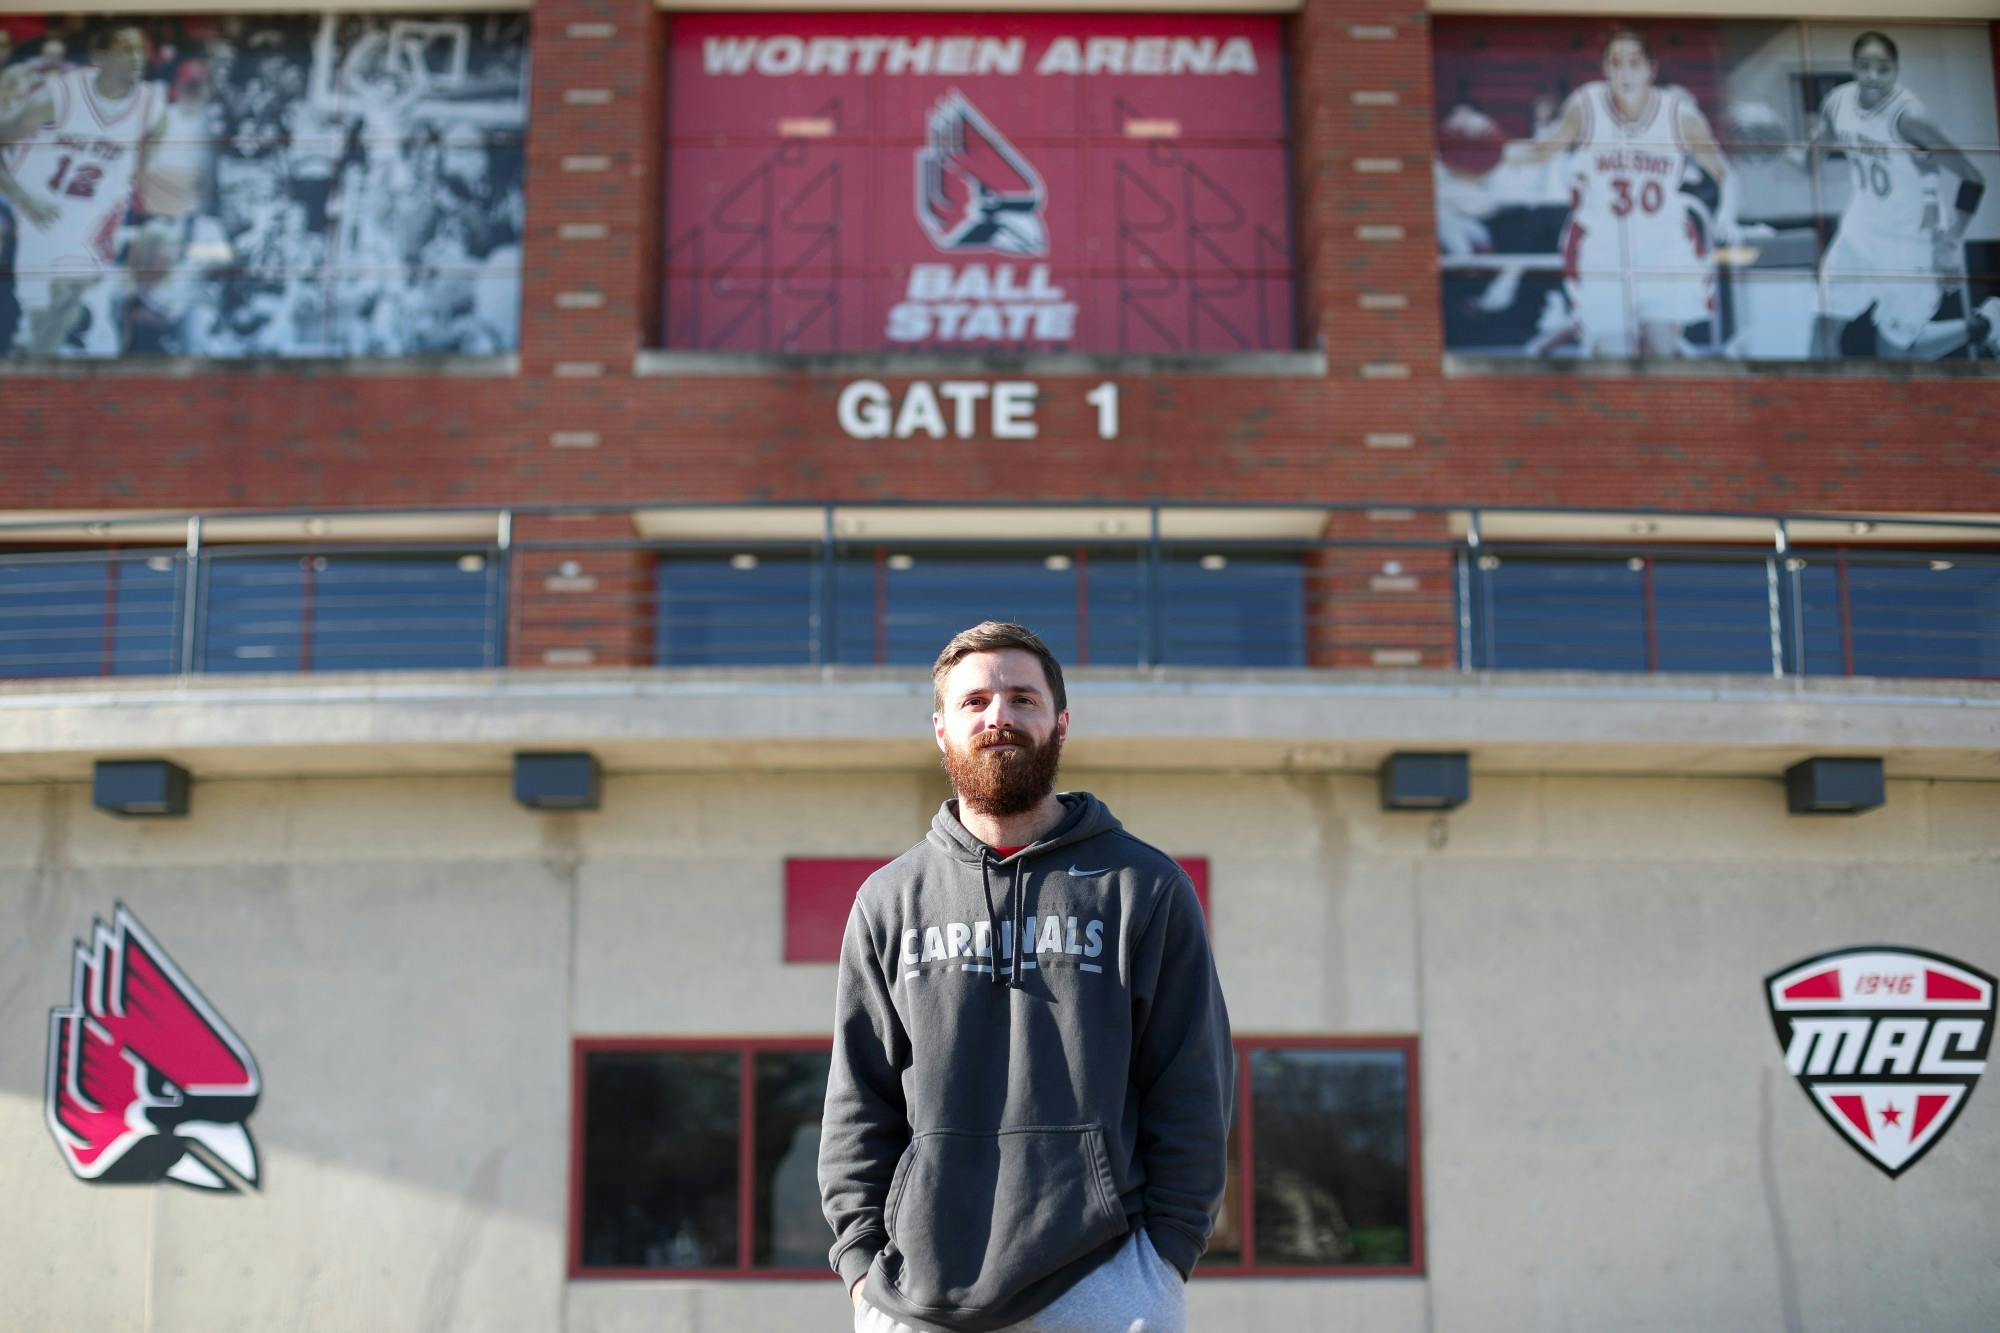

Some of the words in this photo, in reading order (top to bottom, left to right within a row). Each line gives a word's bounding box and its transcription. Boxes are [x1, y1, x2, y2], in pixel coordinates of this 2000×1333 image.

[703, 37, 1023, 73] WORTHEN
[1038, 37, 1256, 73] ARENA
[48, 155, 103, 197] 12
[1853, 157, 1892, 197] 10
[1611, 180, 1662, 216] 30
[908, 264, 1063, 299] BALL
[887, 303, 1076, 340] STATE
[838, 382, 1037, 438] GATE
[1088, 383, 1119, 438] 1
[1855, 974, 1914, 995] 1946
[1785, 1017, 1986, 1075] MAC
